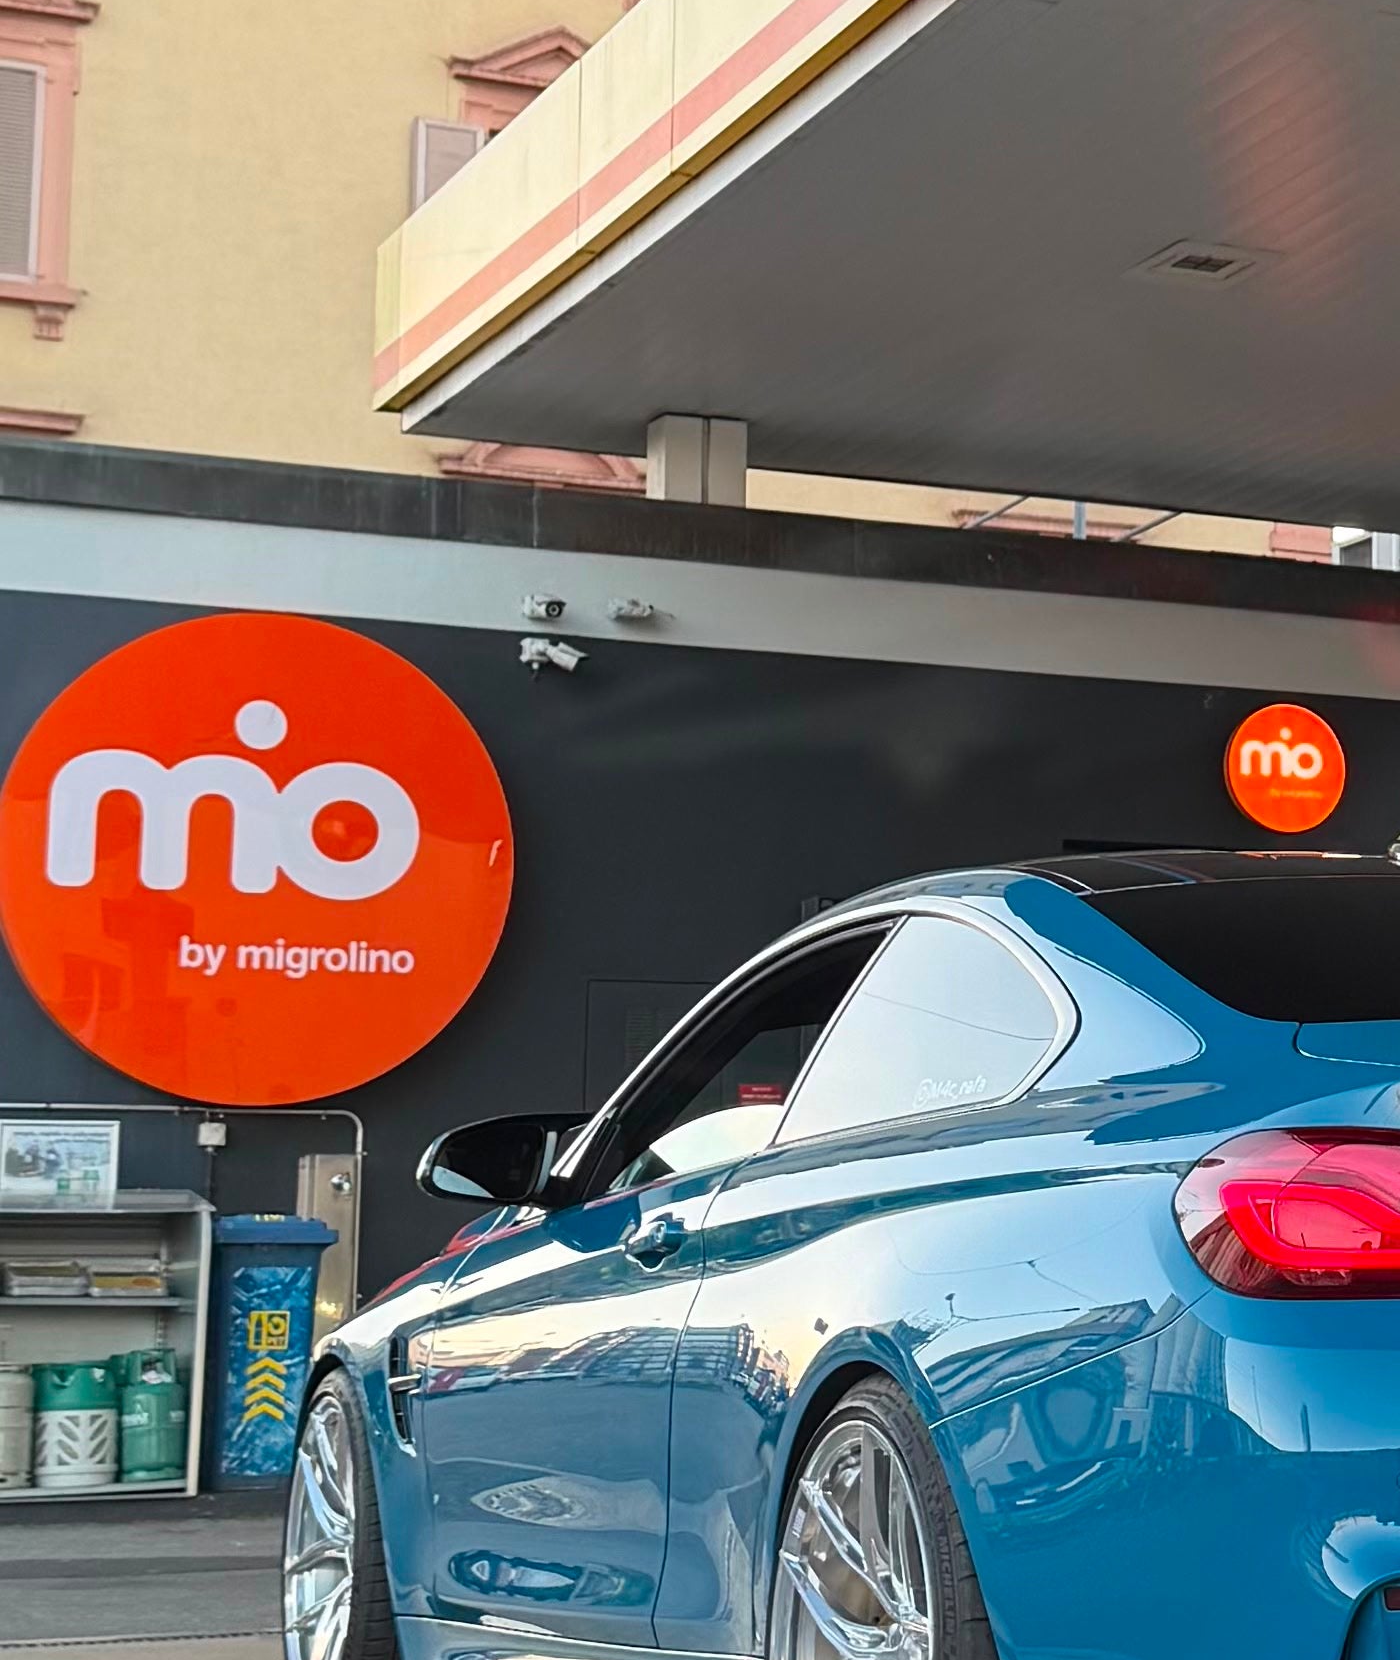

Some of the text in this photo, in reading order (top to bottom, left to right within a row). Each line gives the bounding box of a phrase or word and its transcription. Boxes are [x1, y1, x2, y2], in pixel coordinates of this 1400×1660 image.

[1240, 727, 1323, 779] mio
[46, 700, 420, 901] mio
[178, 934, 415, 979] by migrolino
[937, 1535, 956, 1635] MICHELIN
